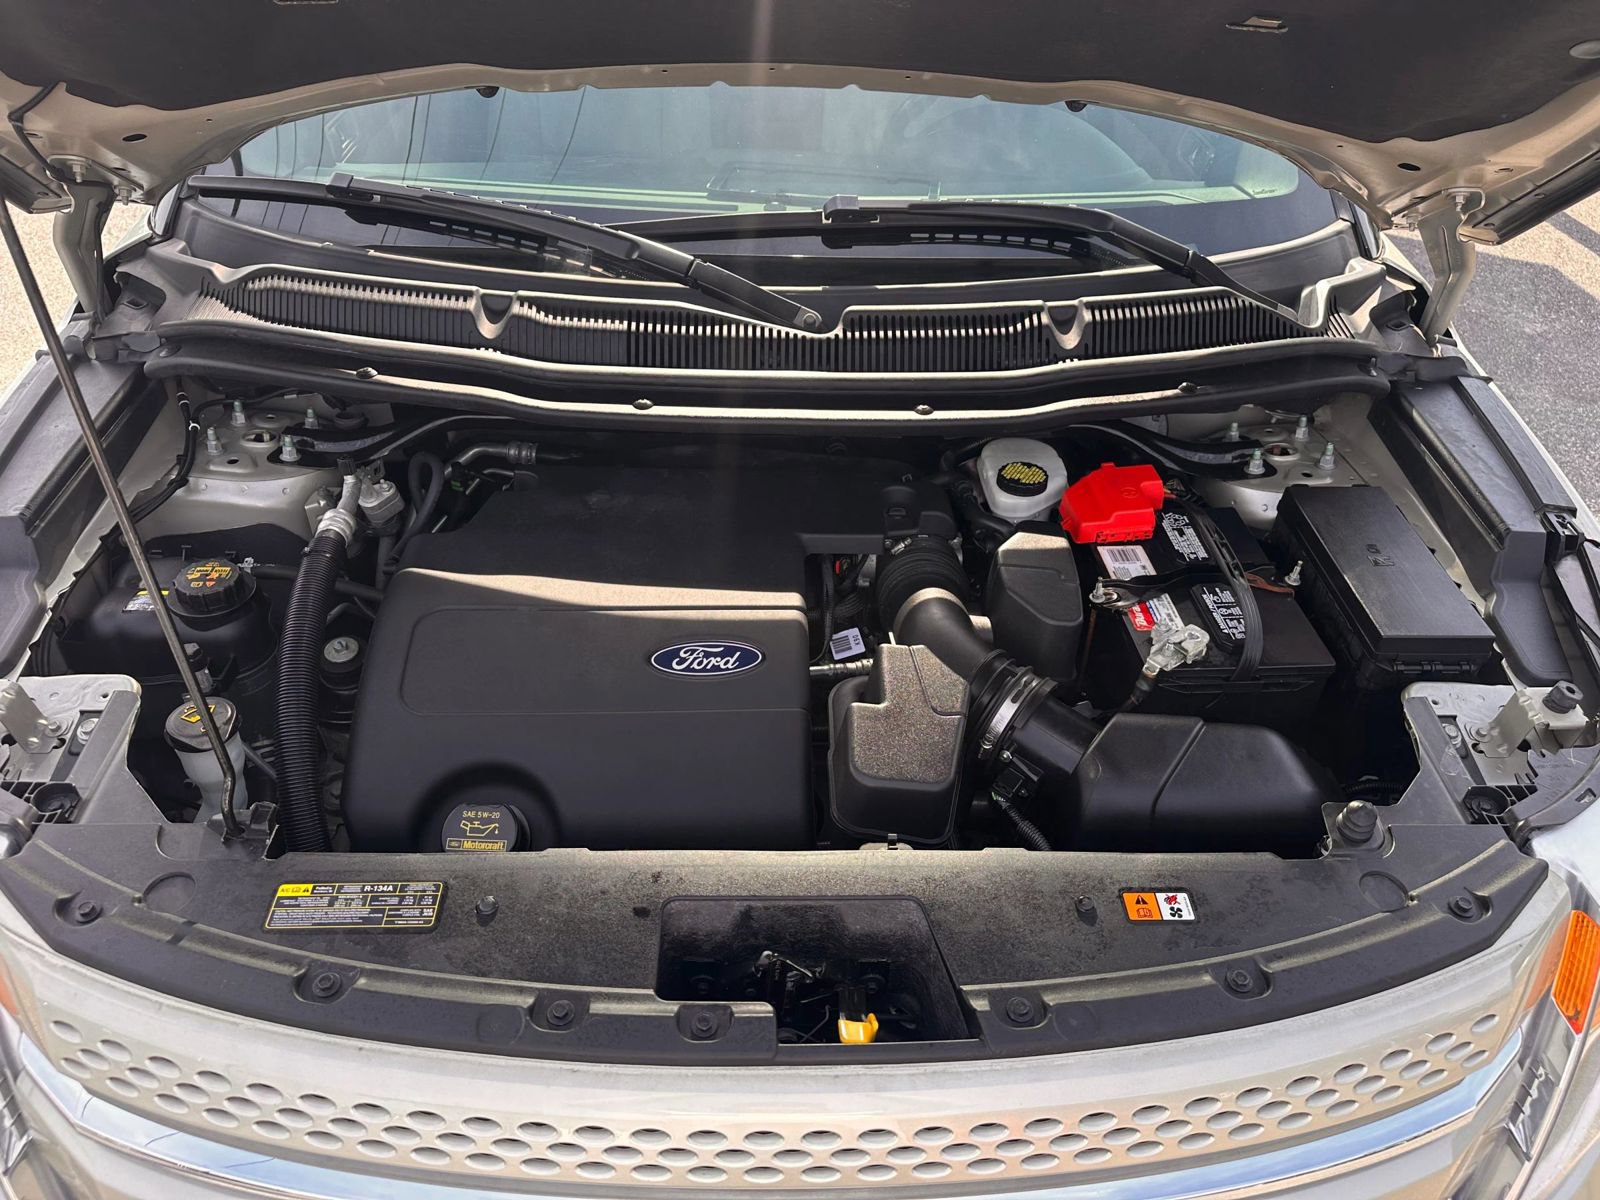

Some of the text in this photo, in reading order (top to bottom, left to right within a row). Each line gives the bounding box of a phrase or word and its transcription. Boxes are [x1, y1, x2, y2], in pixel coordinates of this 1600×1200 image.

[672, 646, 741, 670] Ford
[462, 810, 477, 818] SAE
[462, 840, 505, 850] Motorcraft
[363, 884, 394, 892] R-134A
